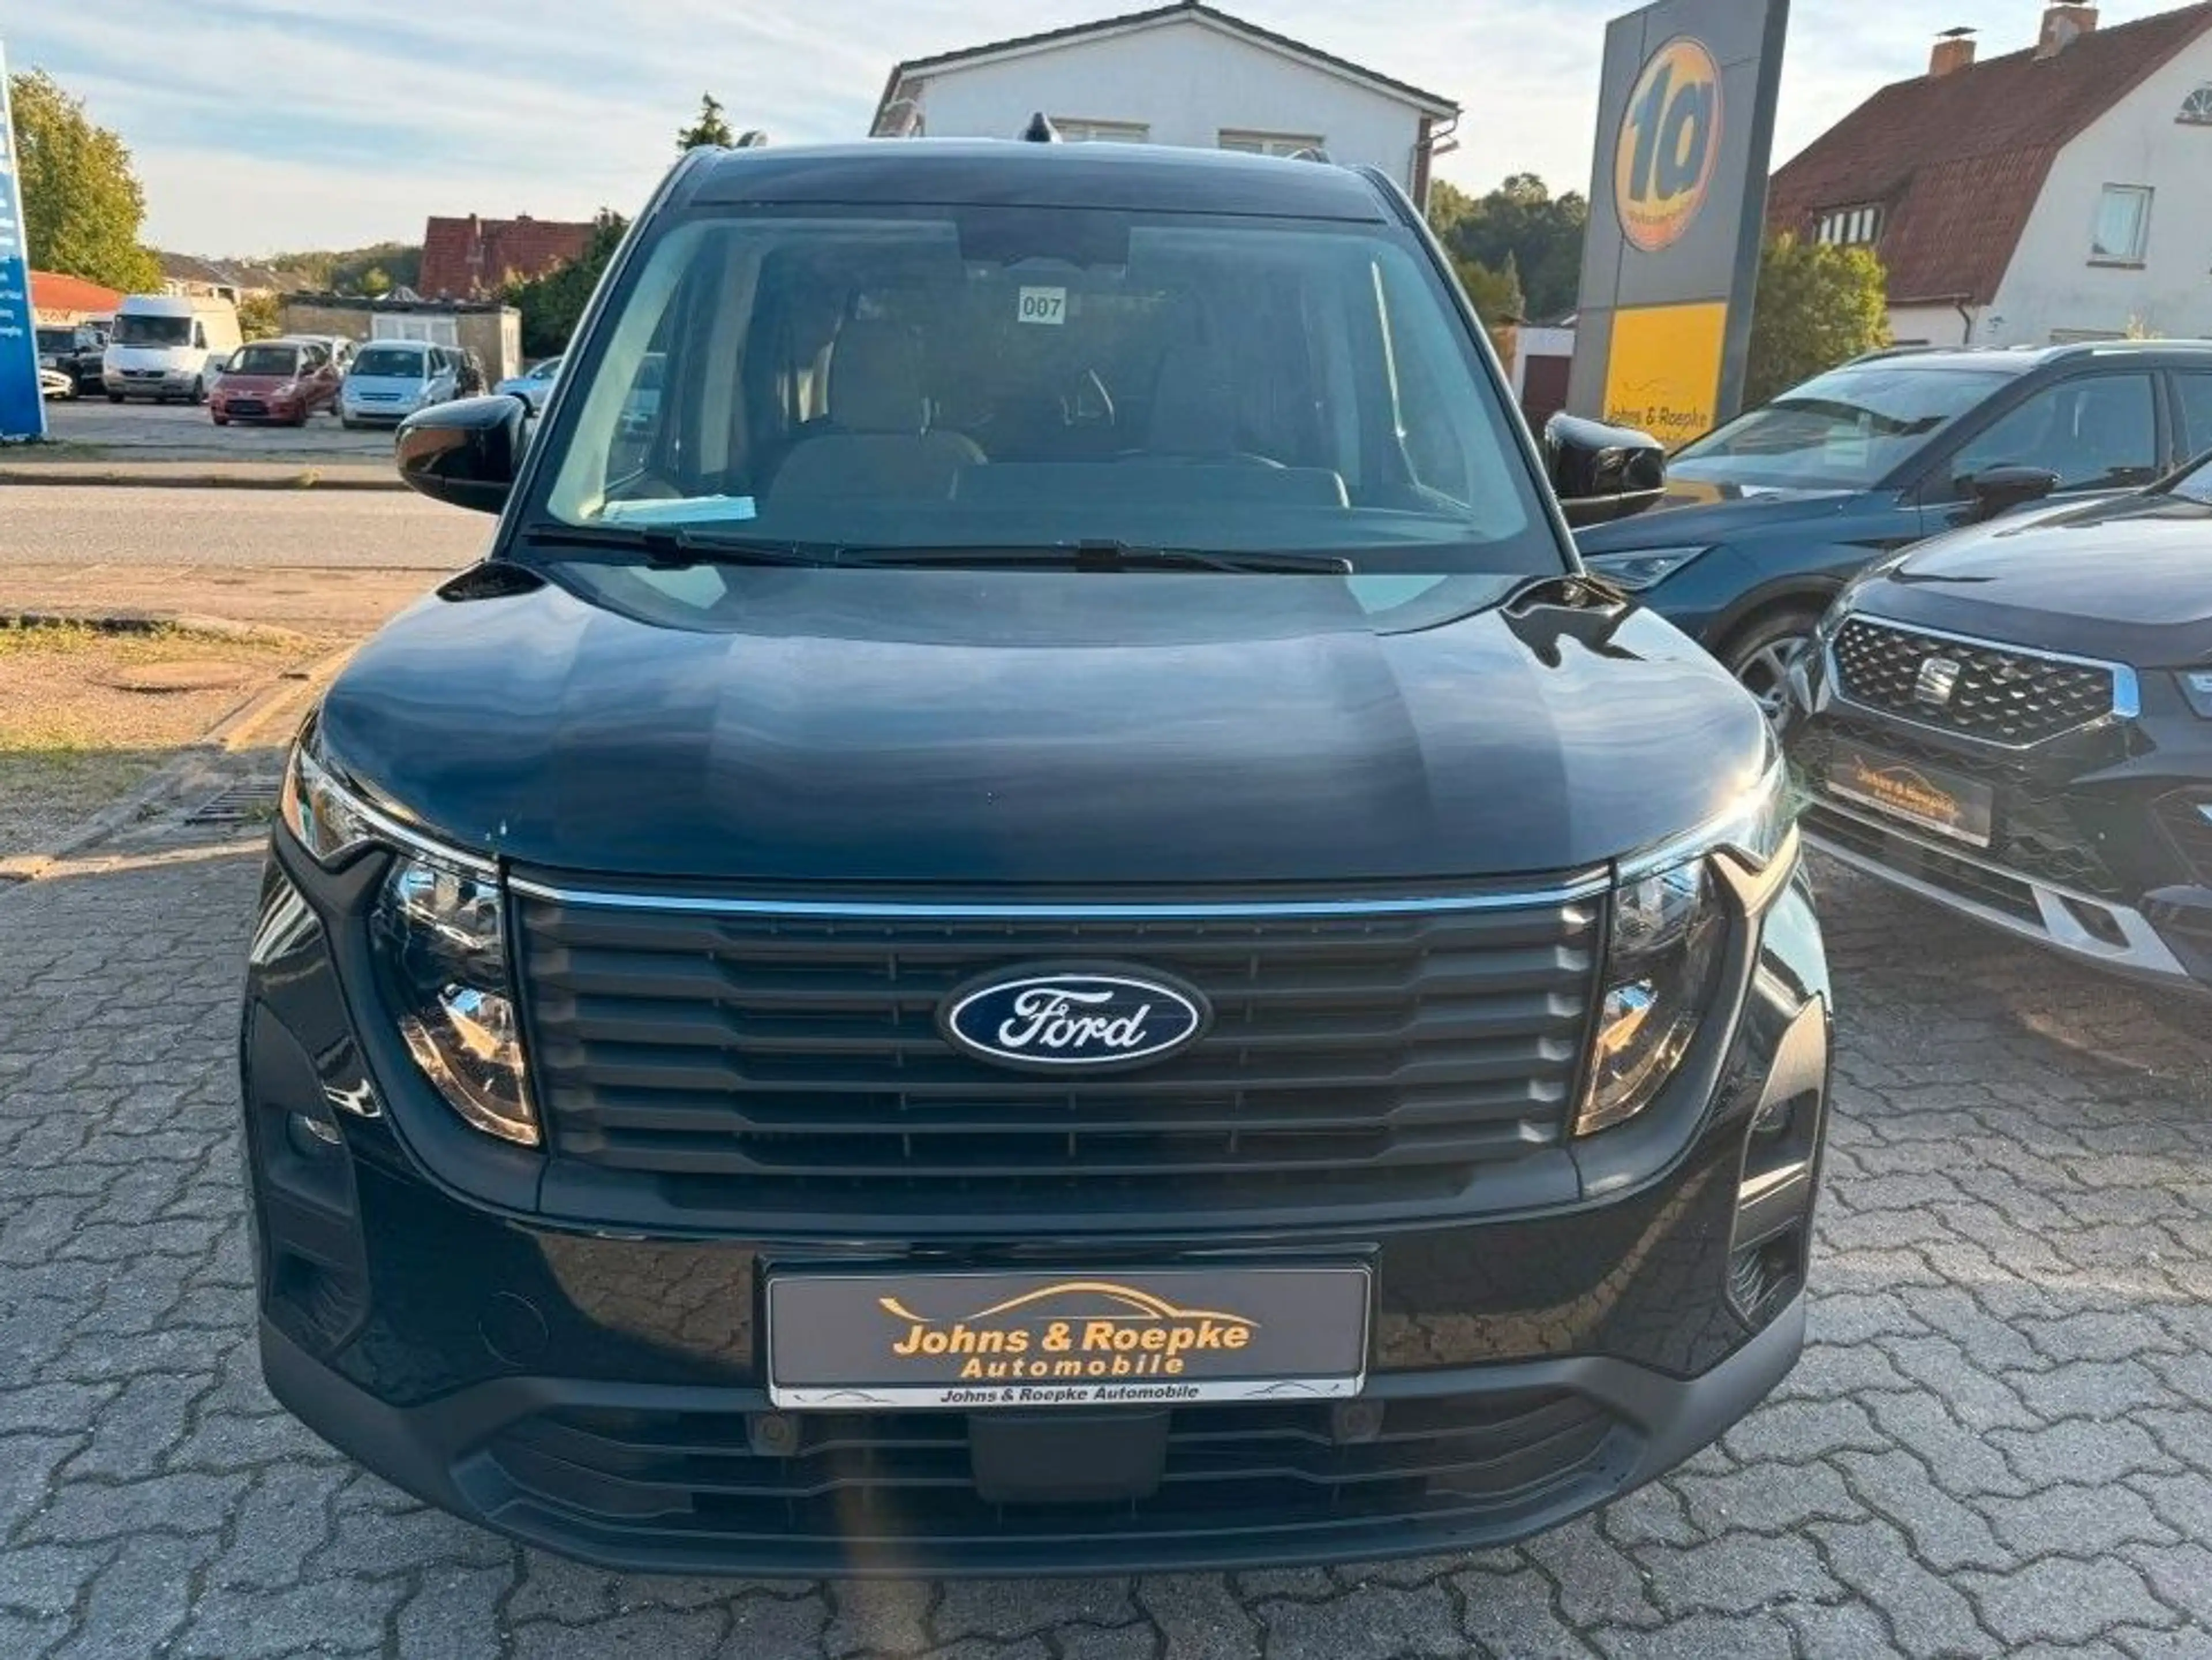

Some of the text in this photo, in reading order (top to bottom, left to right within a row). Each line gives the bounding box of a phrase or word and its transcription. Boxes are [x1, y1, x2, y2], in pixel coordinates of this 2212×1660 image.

[1024, 296, 1062, 316] 007
[999, 988, 1150, 1048] Ford
[893, 1321, 1250, 1356] Johns & Roepke
[960, 1354, 1184, 1378] Automobile
[940, 1385, 1199, 1403] Johns & Roepke Automobile
